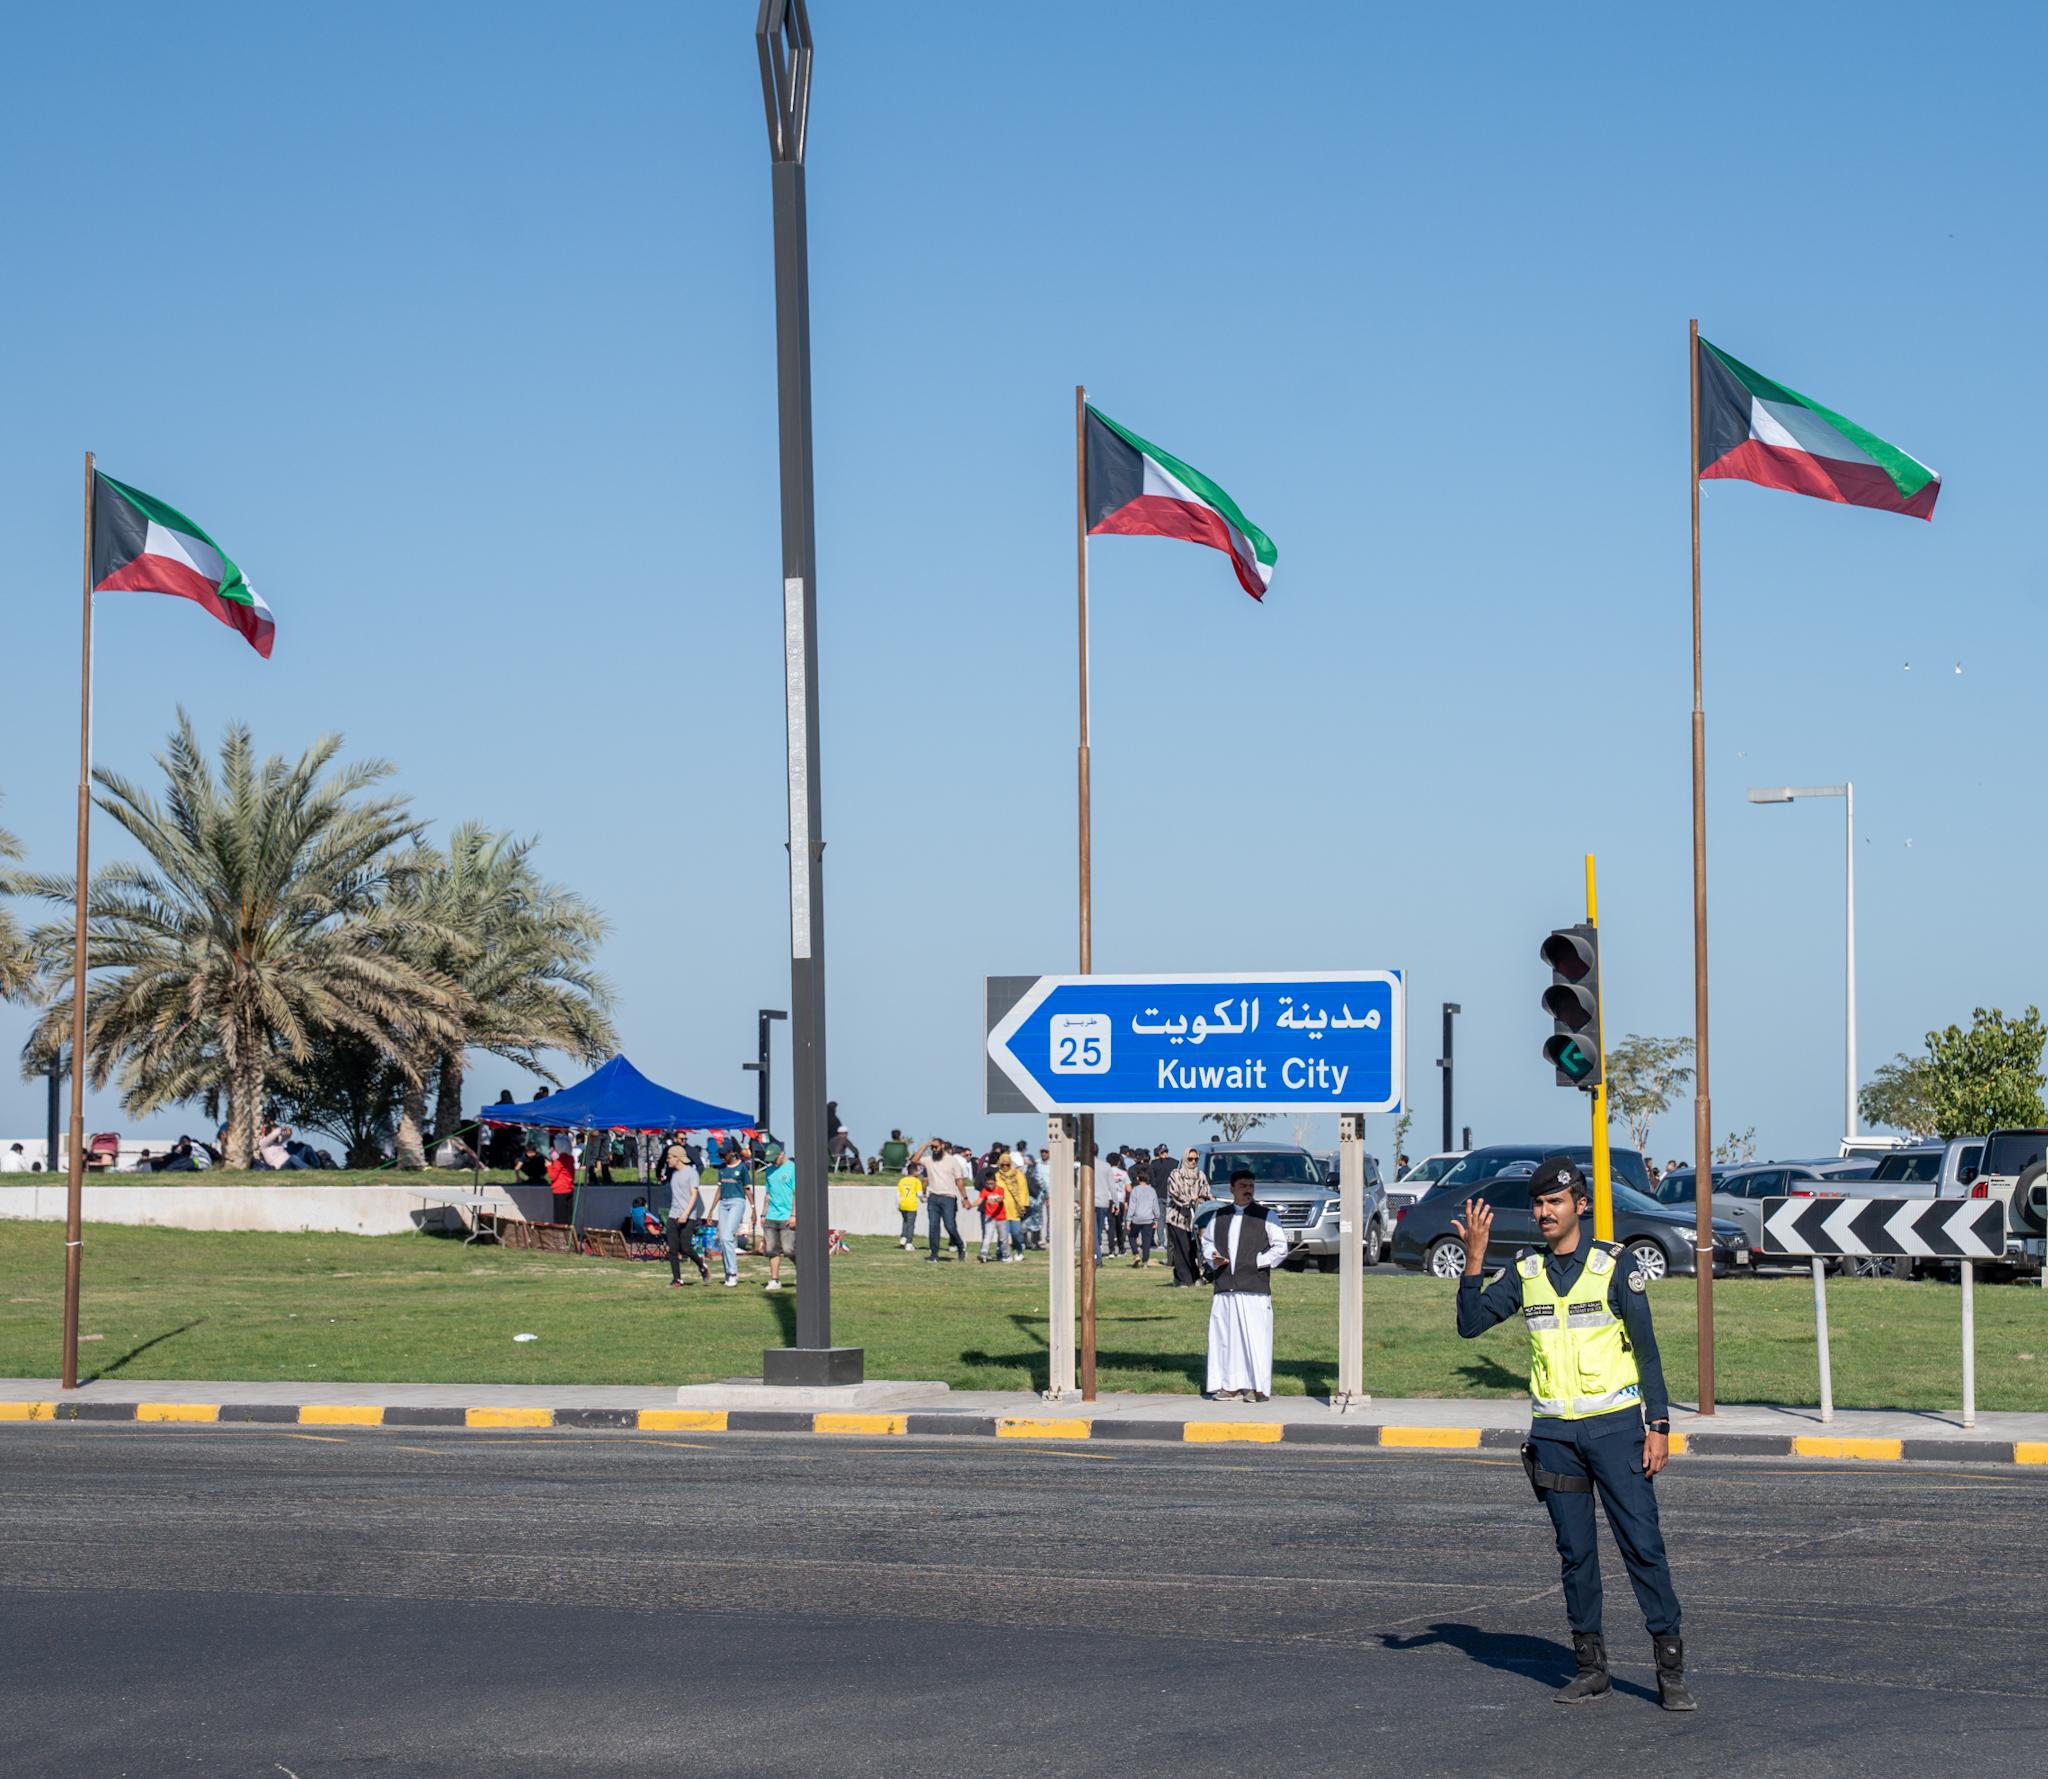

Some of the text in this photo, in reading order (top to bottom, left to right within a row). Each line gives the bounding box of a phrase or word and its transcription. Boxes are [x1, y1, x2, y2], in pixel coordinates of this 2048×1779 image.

[1131, 996, 1381, 1045] مدينة الكويت
[1060, 1037, 1102, 1067] 25
[1158, 1057, 1349, 1095] Kuwait City
